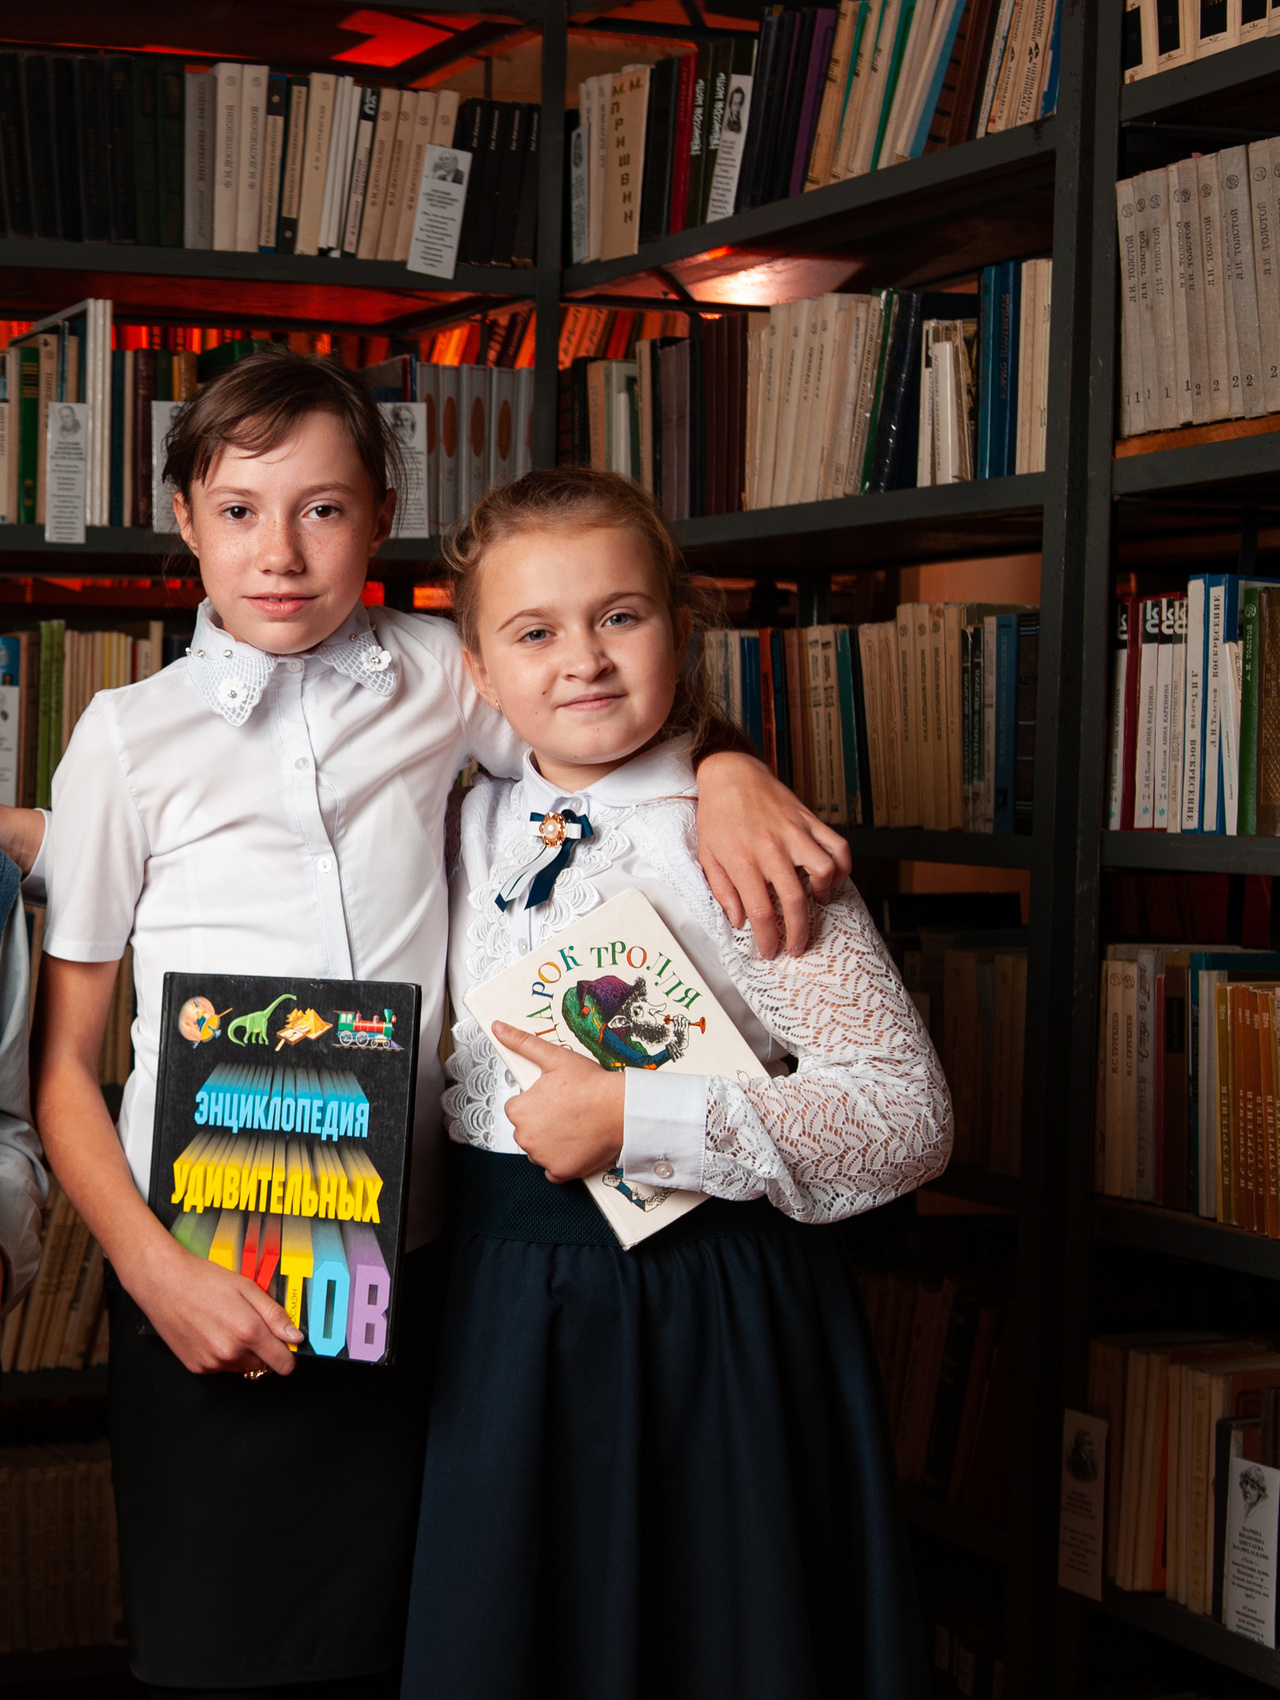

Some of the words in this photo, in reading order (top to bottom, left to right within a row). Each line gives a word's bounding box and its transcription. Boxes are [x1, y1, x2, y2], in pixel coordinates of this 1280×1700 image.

[1001, 66, 1012, 106] ПУШКИН
[1021, 67, 1030, 106] ПУШКИН
[1027, 63, 1037, 102] ПУШКИН
[1184, 221, 1193, 268] ТОЛСТОЙ
[1204, 216, 1213, 263] ТОЛСТОЙ
[1230, 208, 1241, 256] ТОЛСТОЙ
[1257, 201, 1269, 251] ТОЛСТОЙ
[1126, 235, 1136, 280] ТОЛСТОЙ
[1138, 230, 1146, 276] ТОЛСТОЙ
[1153, 226, 1162, 272] ТОЛСТОЙ
[1165, 387, 1170, 398] 1
[1185, 380, 1191, 391] 1
[1195, 383, 1202, 395] 2
[1213, 380, 1219, 391] 2
[1232, 376, 1239, 387] 2
[1246, 375, 1253, 386] 2
[1270, 366, 1278, 378] 2
[1135, 392, 1140, 403] 1
[1187, 740, 1197, 821] ВОСКРЕСЕНИЕ
[589, 940, 703, 1011] ТРОЛЛЯ
[194, 1090, 370, 1142] ЭНЦИКЛОПЕДИЯ
[171, 1161, 384, 1224] УДИВИТЕЛЬНЫХ
[290, 1285, 299, 1326] ОСМЭН
